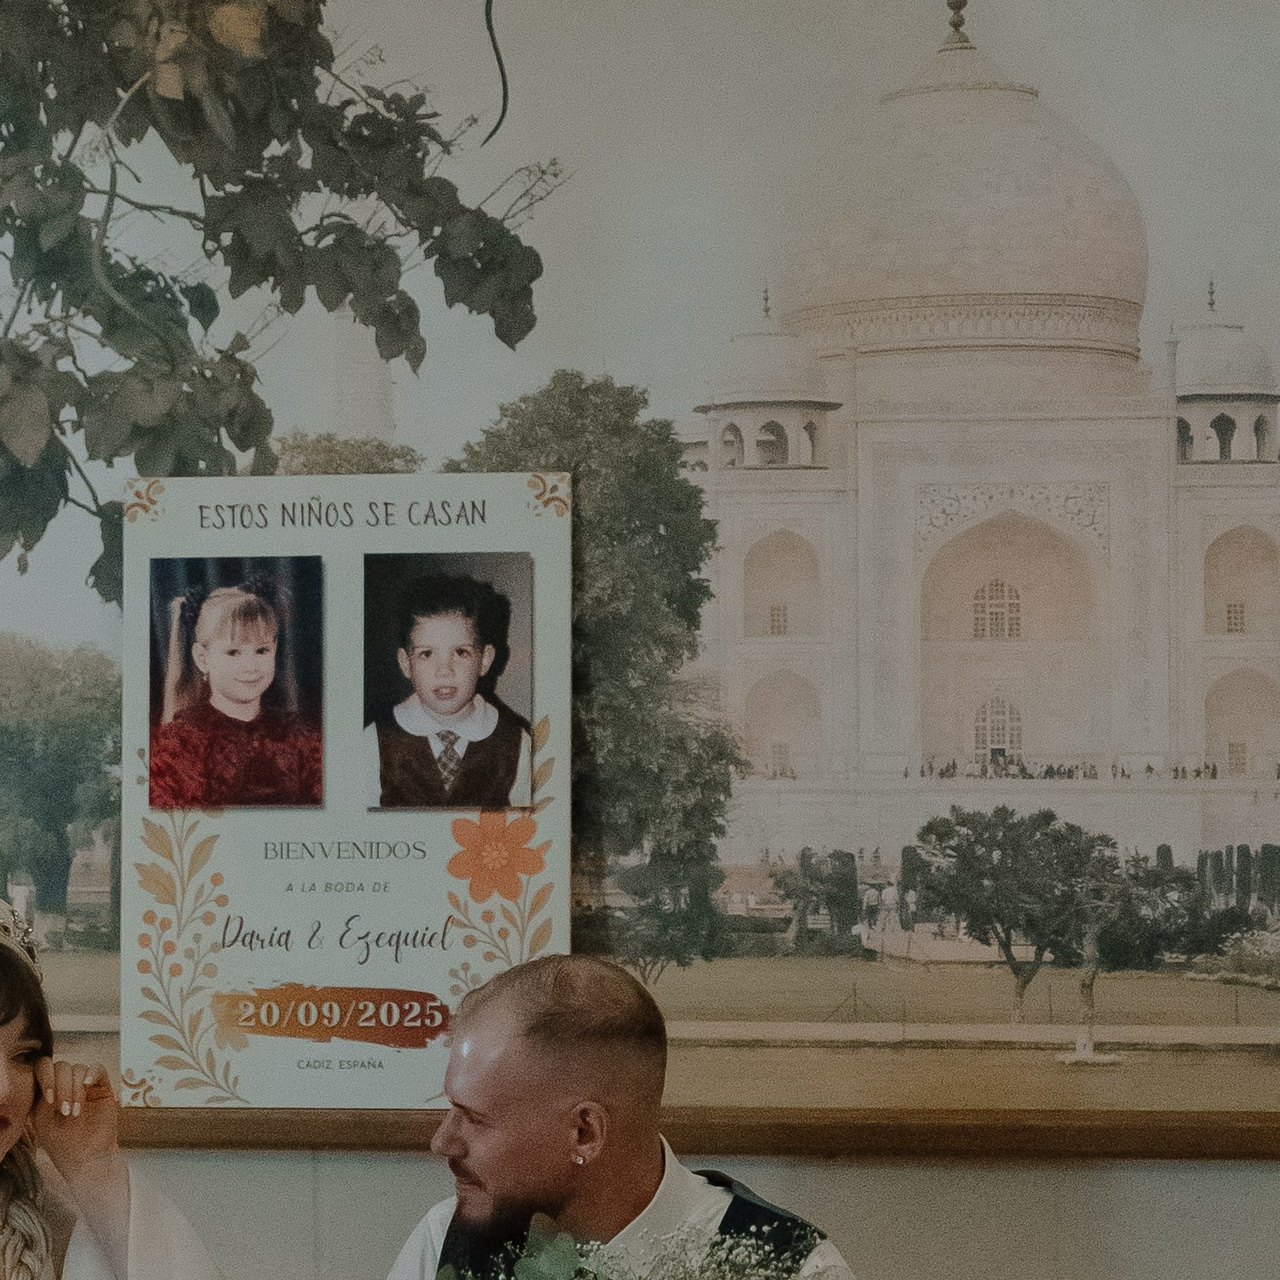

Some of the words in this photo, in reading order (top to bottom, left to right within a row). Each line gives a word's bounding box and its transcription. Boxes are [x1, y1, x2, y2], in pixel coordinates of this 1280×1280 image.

[198, 503, 269, 530] ESTOS
[280, 496, 354, 527] NIÑOS
[365, 501, 396, 527] SE
[408, 499, 487, 526] CASAN
[263, 841, 427, 861] BIENVENIDOS
[286, 882, 294, 892] A
[301, 882, 317, 893] LA
[324, 882, 365, 893] BODA
[372, 882, 391, 893] DE
[221, 915, 291, 952] Daria
[308, 920, 322, 950] &
[339, 914, 455, 966] Ezequiel
[237, 1000, 444, 1028] 20/09/2025
[338, 1058, 385, 1070] ESPAÑA
